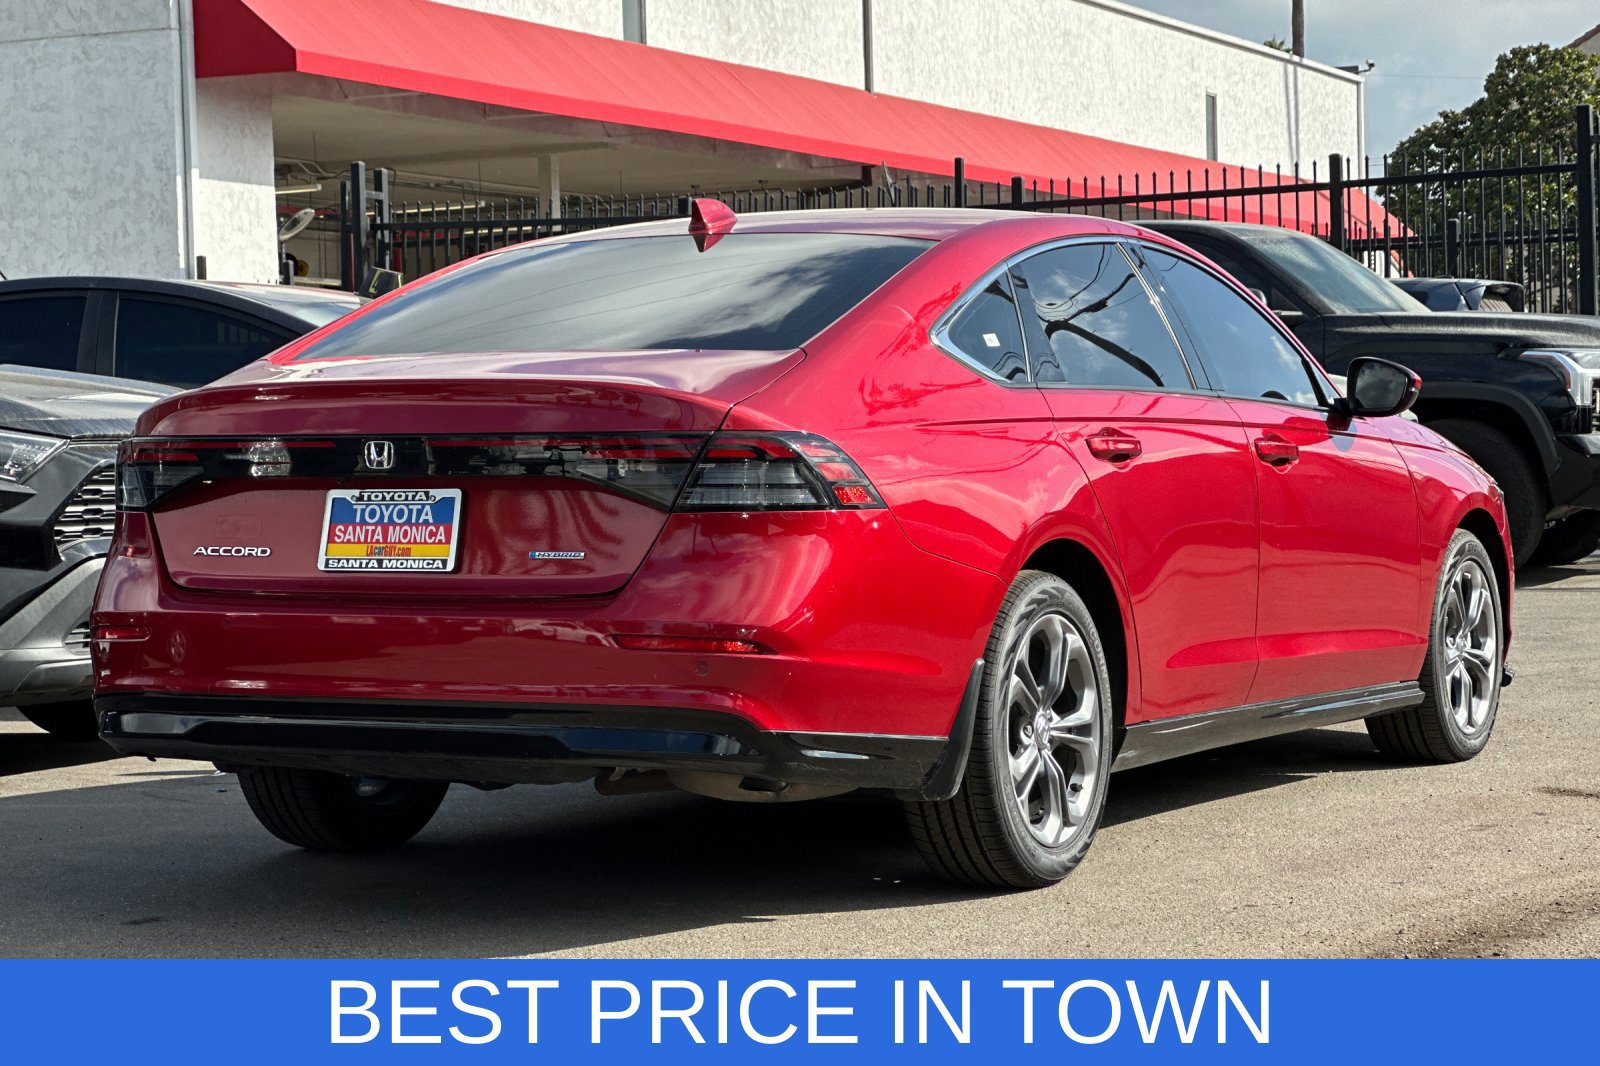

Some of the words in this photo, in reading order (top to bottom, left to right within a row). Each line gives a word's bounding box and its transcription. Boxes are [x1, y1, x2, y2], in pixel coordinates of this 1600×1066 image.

[361, 491, 427, 501] TOYOTA
[352, 504, 434, 524] TOYOTA
[334, 525, 383, 543] SANTA
[387, 525, 446, 543] MONICA
[193, 546, 271, 557] ACCORD
[328, 559, 379, 568] SANTA
[382, 559, 443, 569] MONICA
